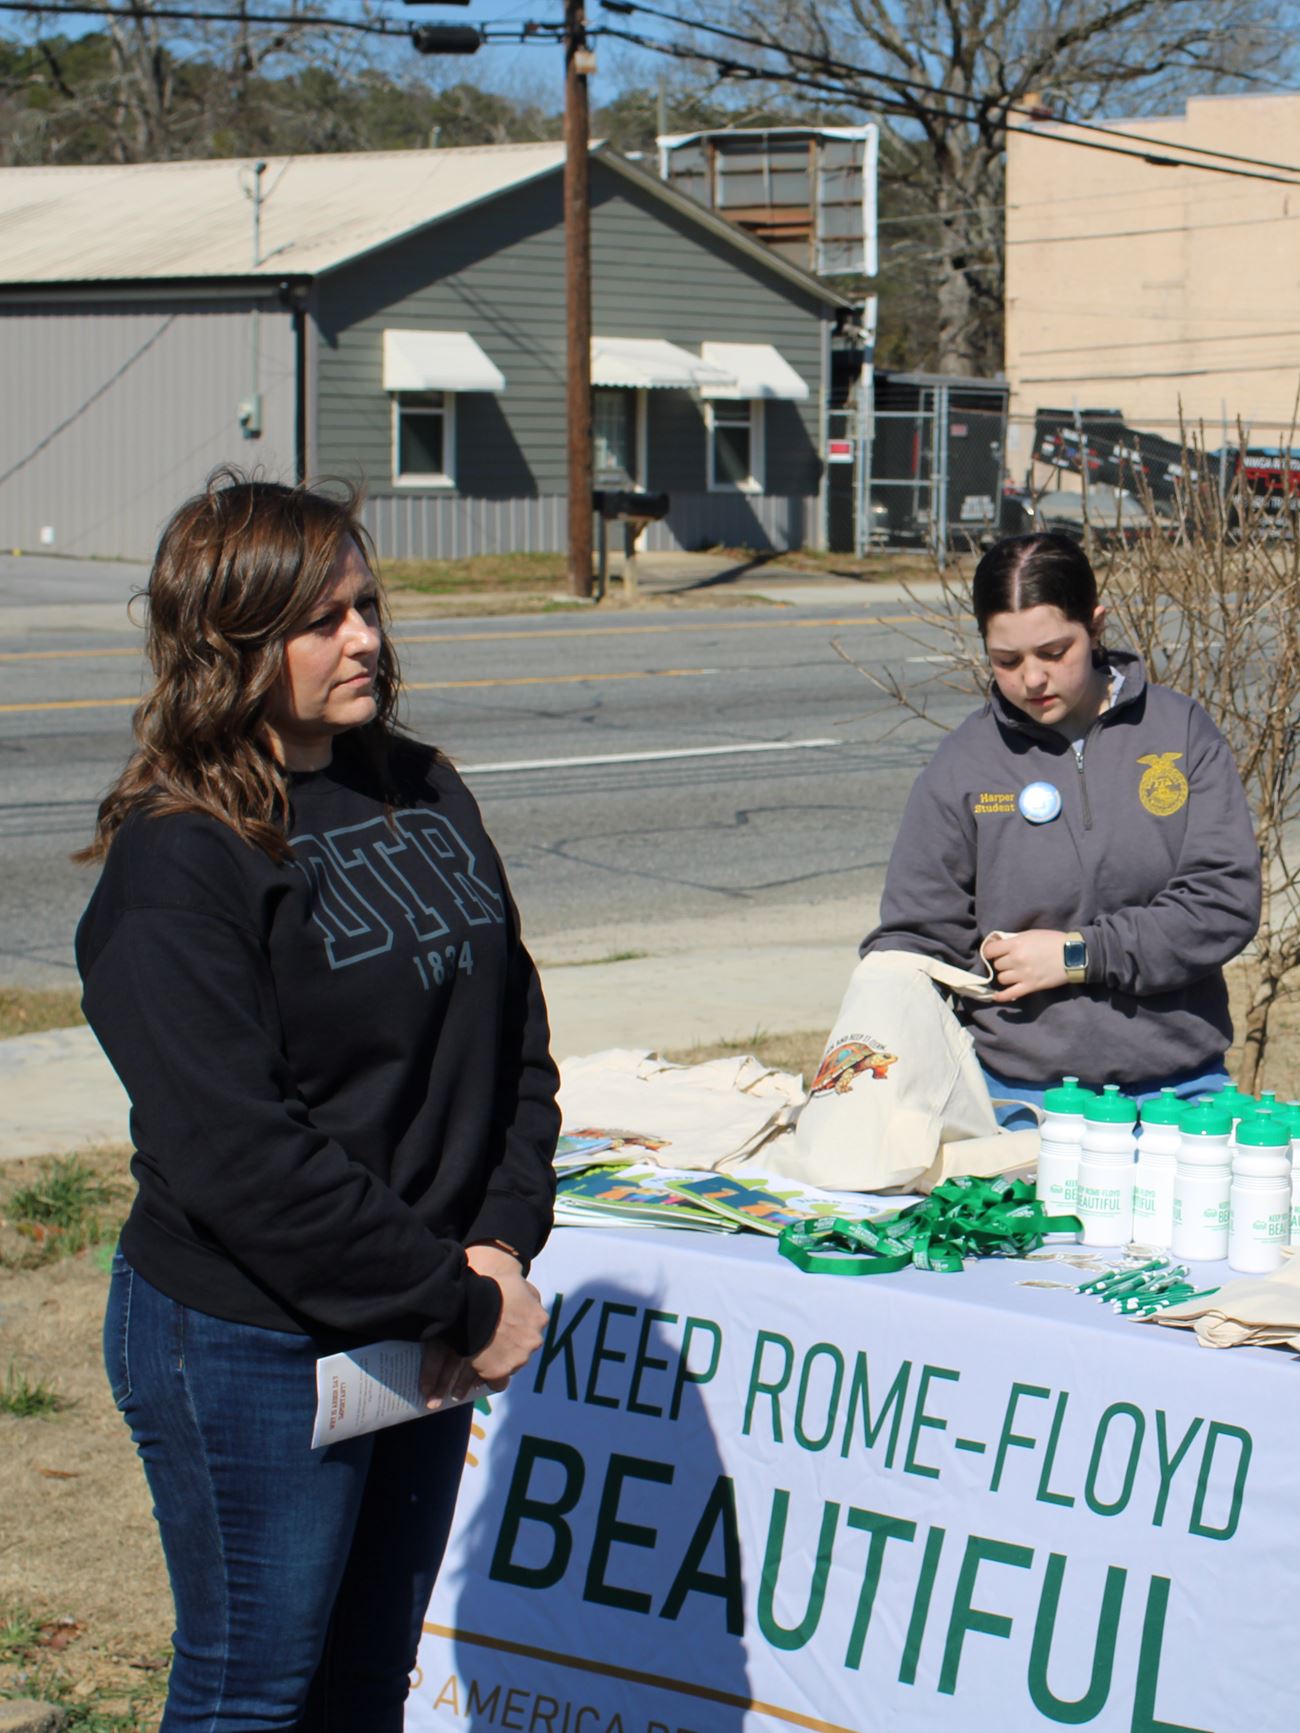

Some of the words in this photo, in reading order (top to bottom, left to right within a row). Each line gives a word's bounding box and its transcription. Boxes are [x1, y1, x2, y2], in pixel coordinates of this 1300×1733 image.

[980, 793, 1015, 804] Harper
[974, 803, 1015, 814] Student
[1079, 1195, 1121, 1211] EAUTIFUL
[533, 1292, 722, 1420] KEEP
[742, 1330, 1253, 1541] ROME-FLOYD
[488, 1434, 1215, 1733] BEAUTIFUL
